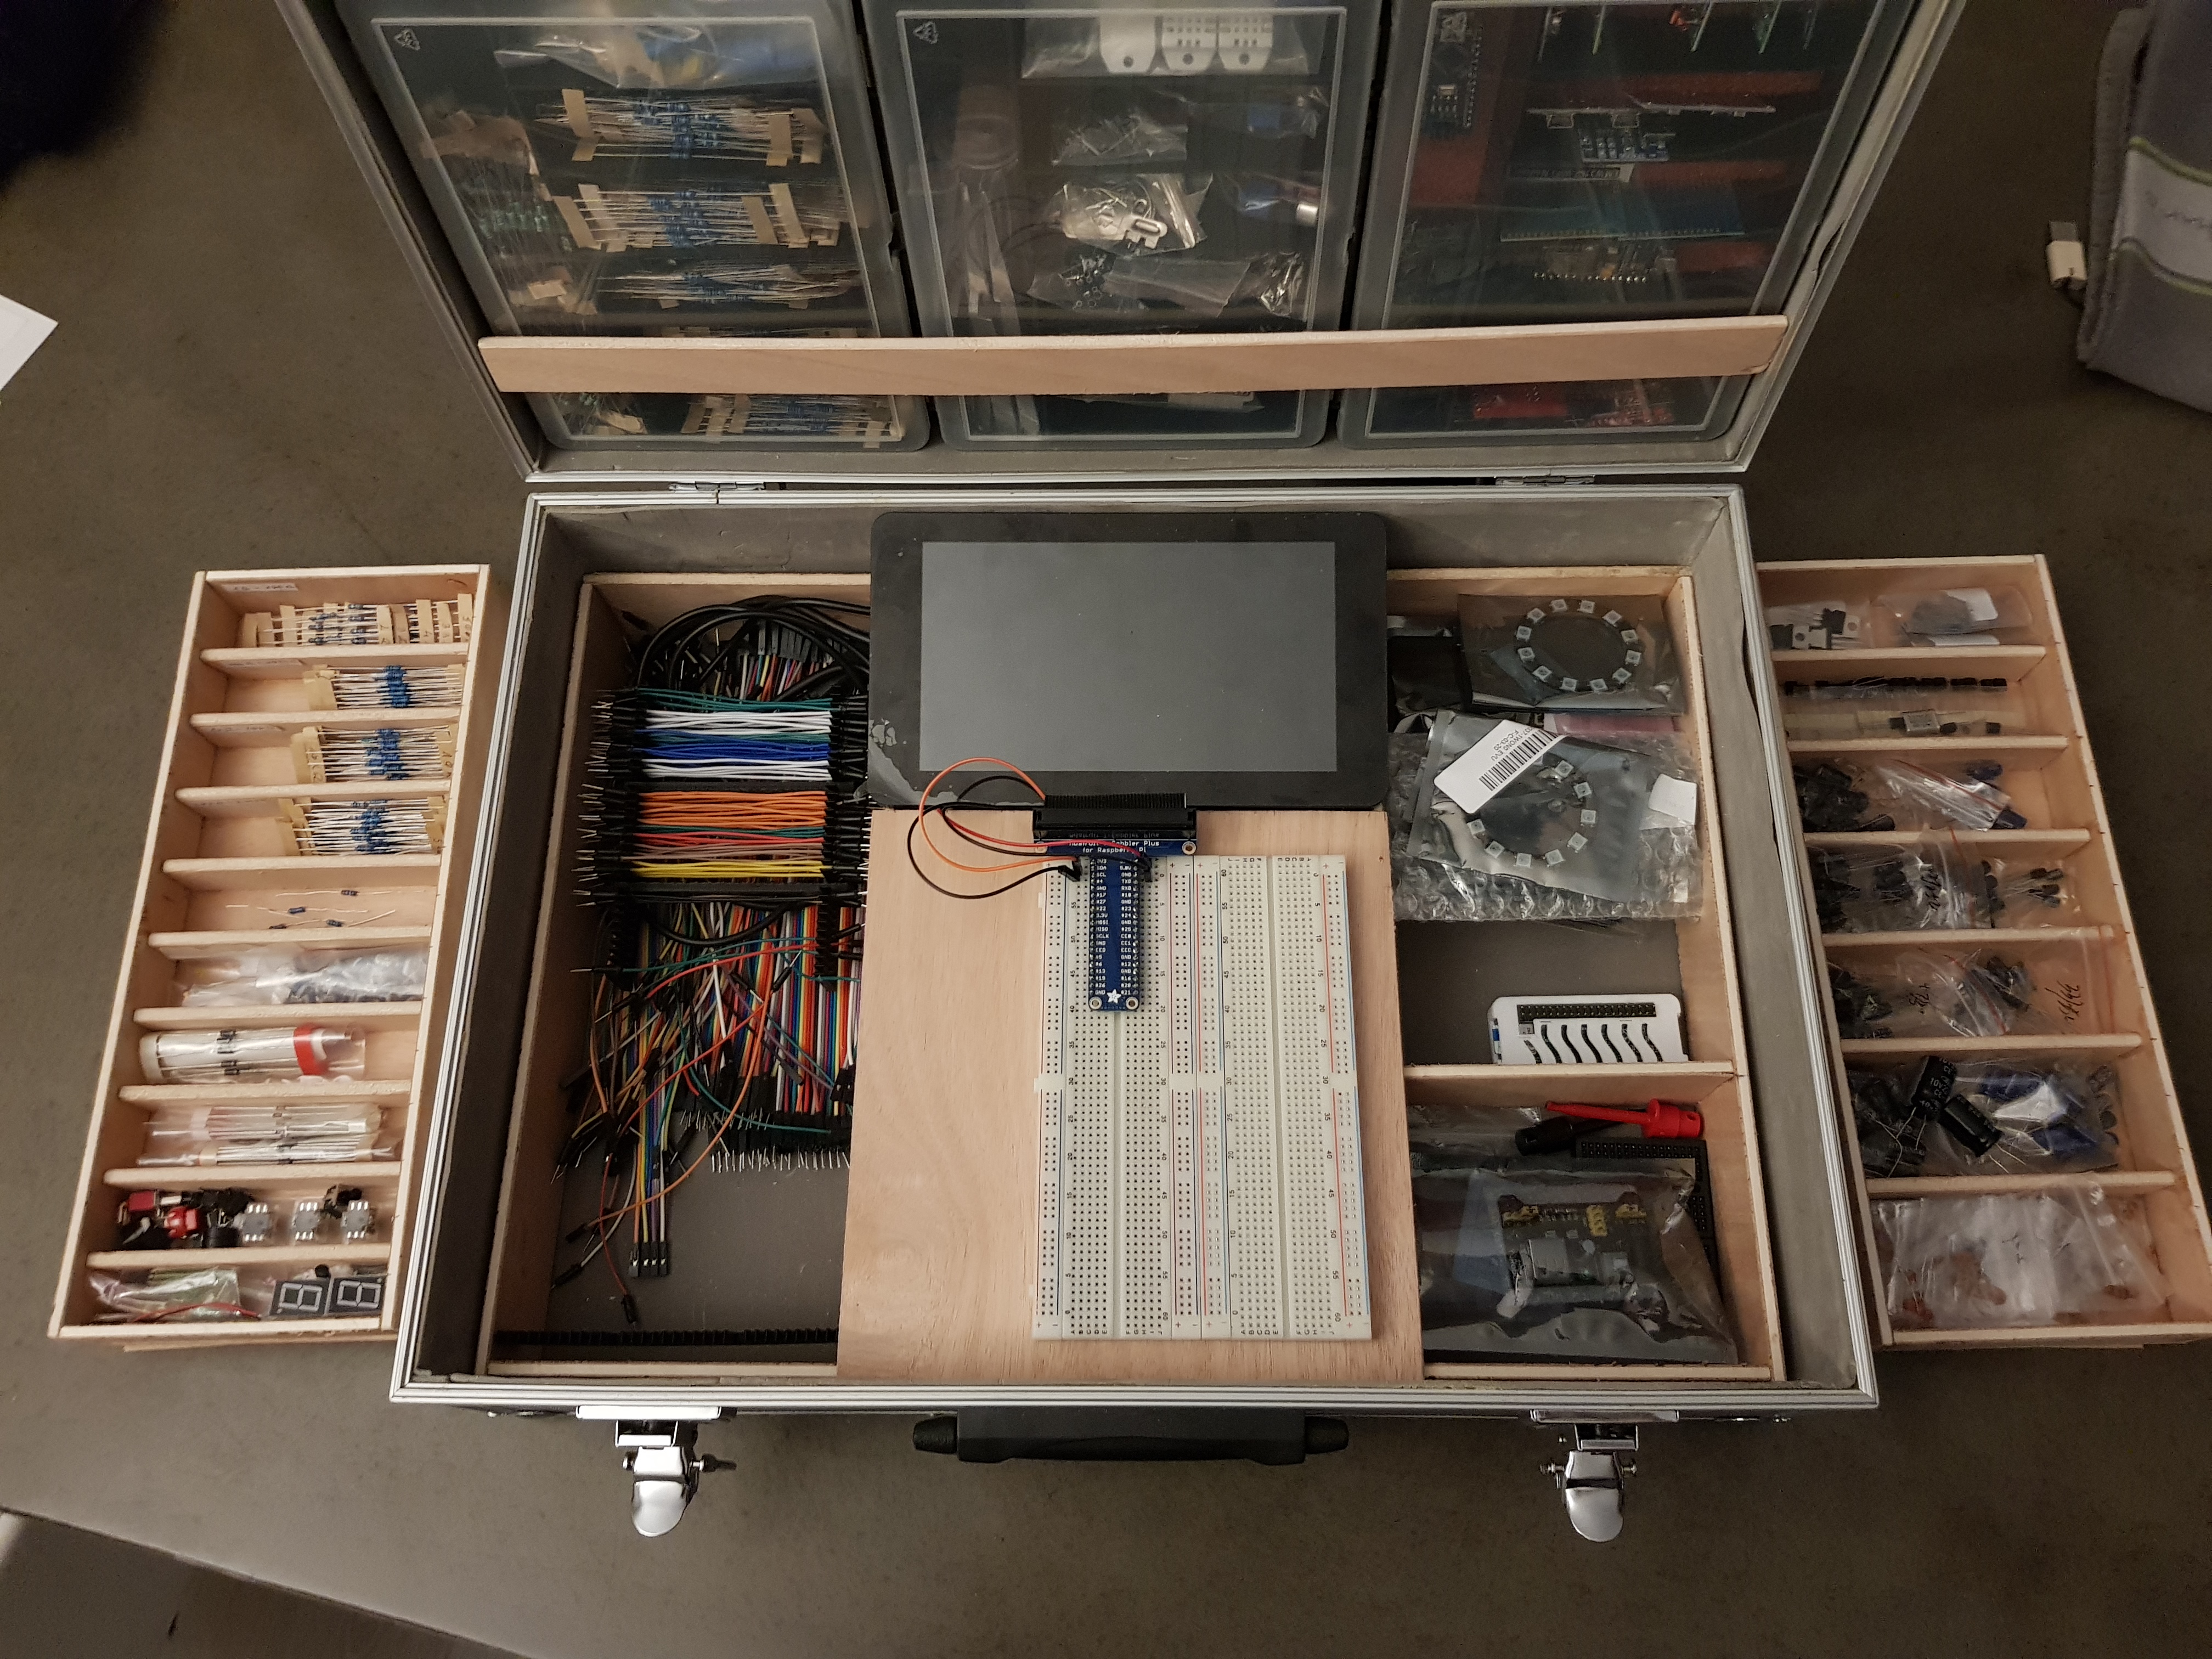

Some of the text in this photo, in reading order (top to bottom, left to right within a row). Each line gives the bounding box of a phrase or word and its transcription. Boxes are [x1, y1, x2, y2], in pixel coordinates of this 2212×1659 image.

[1493, 729, 1519, 751] F-C-03-20
[1491, 749, 1504, 761] EVU
[1221, 869, 1227, 877] 60
[1222, 936, 1228, 944] 50
[1223, 970, 1229, 979] 45
[1069, 1005, 1075, 1013] 40
[1224, 1005, 1230, 1013] 40
[1319, 1004, 1325, 1013] 20
[1069, 1041, 1075, 1049] 35
[1160, 1041, 1166, 1049] 25
[1225, 1041, 1231, 1049] 35
[1321, 1039, 1327, 1048] 25
[1068, 1077, 1074, 1086] 30
[1160, 1077, 1166, 1086] 30
[1226, 1077, 1232, 1085] 30
[1322, 1076, 1329, 1084] 30
[1068, 1115, 1074, 1123] 25
[1161, 1115, 1167, 1123] 35
[1227, 1113, 1233, 1121] 25
[1324, 1113, 1331, 1121] 35
[1067, 1153, 1073, 1161] 20
[1161, 1153, 1167, 1161] 40
[1228, 1151, 1234, 1159] 20
[1327, 1150, 1333, 1159] 40
[1161, 1191, 1167, 1199] 45
[1229, 1189, 1235, 1198] 15
[1328, 1189, 1335, 1198] 45
[1162, 1231, 1168, 1239] 50
[1230, 1230, 1236, 1238] 10
[1330, 1229, 1337, 1239] 50
[1163, 1271, 1168, 1279] 55
[1332, 1270, 1339, 1280] 55
[1163, 1312, 1169, 1321] 60
[1334, 1312, 1341, 1322] 60
